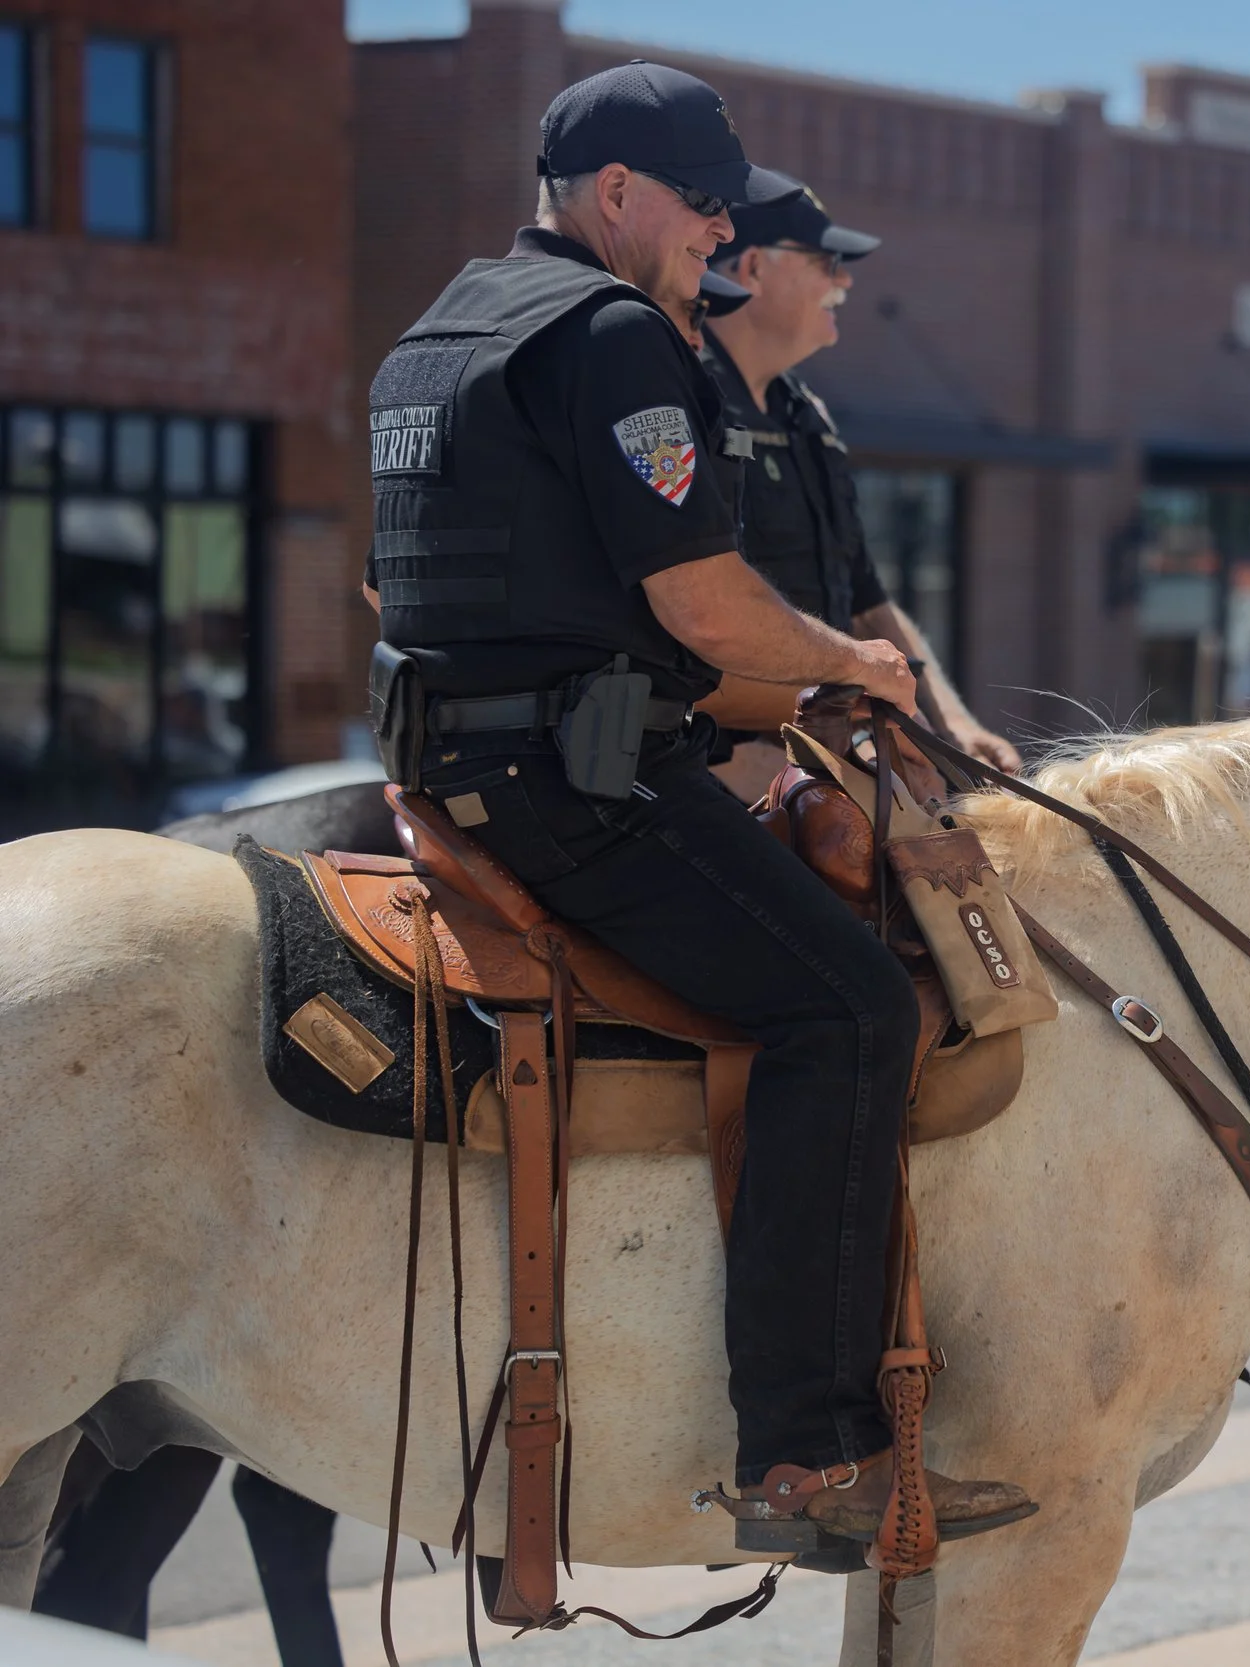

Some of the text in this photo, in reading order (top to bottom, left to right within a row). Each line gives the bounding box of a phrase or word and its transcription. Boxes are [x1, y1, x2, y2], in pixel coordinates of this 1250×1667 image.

[401, 406, 439, 427] COUNTY
[623, 408, 681, 432] SHERIFF
[621, 421, 685, 440] OKLAHOMA COUNTY
[371, 427, 436, 473] HERIFF
[969, 912, 1011, 979] OCSO
